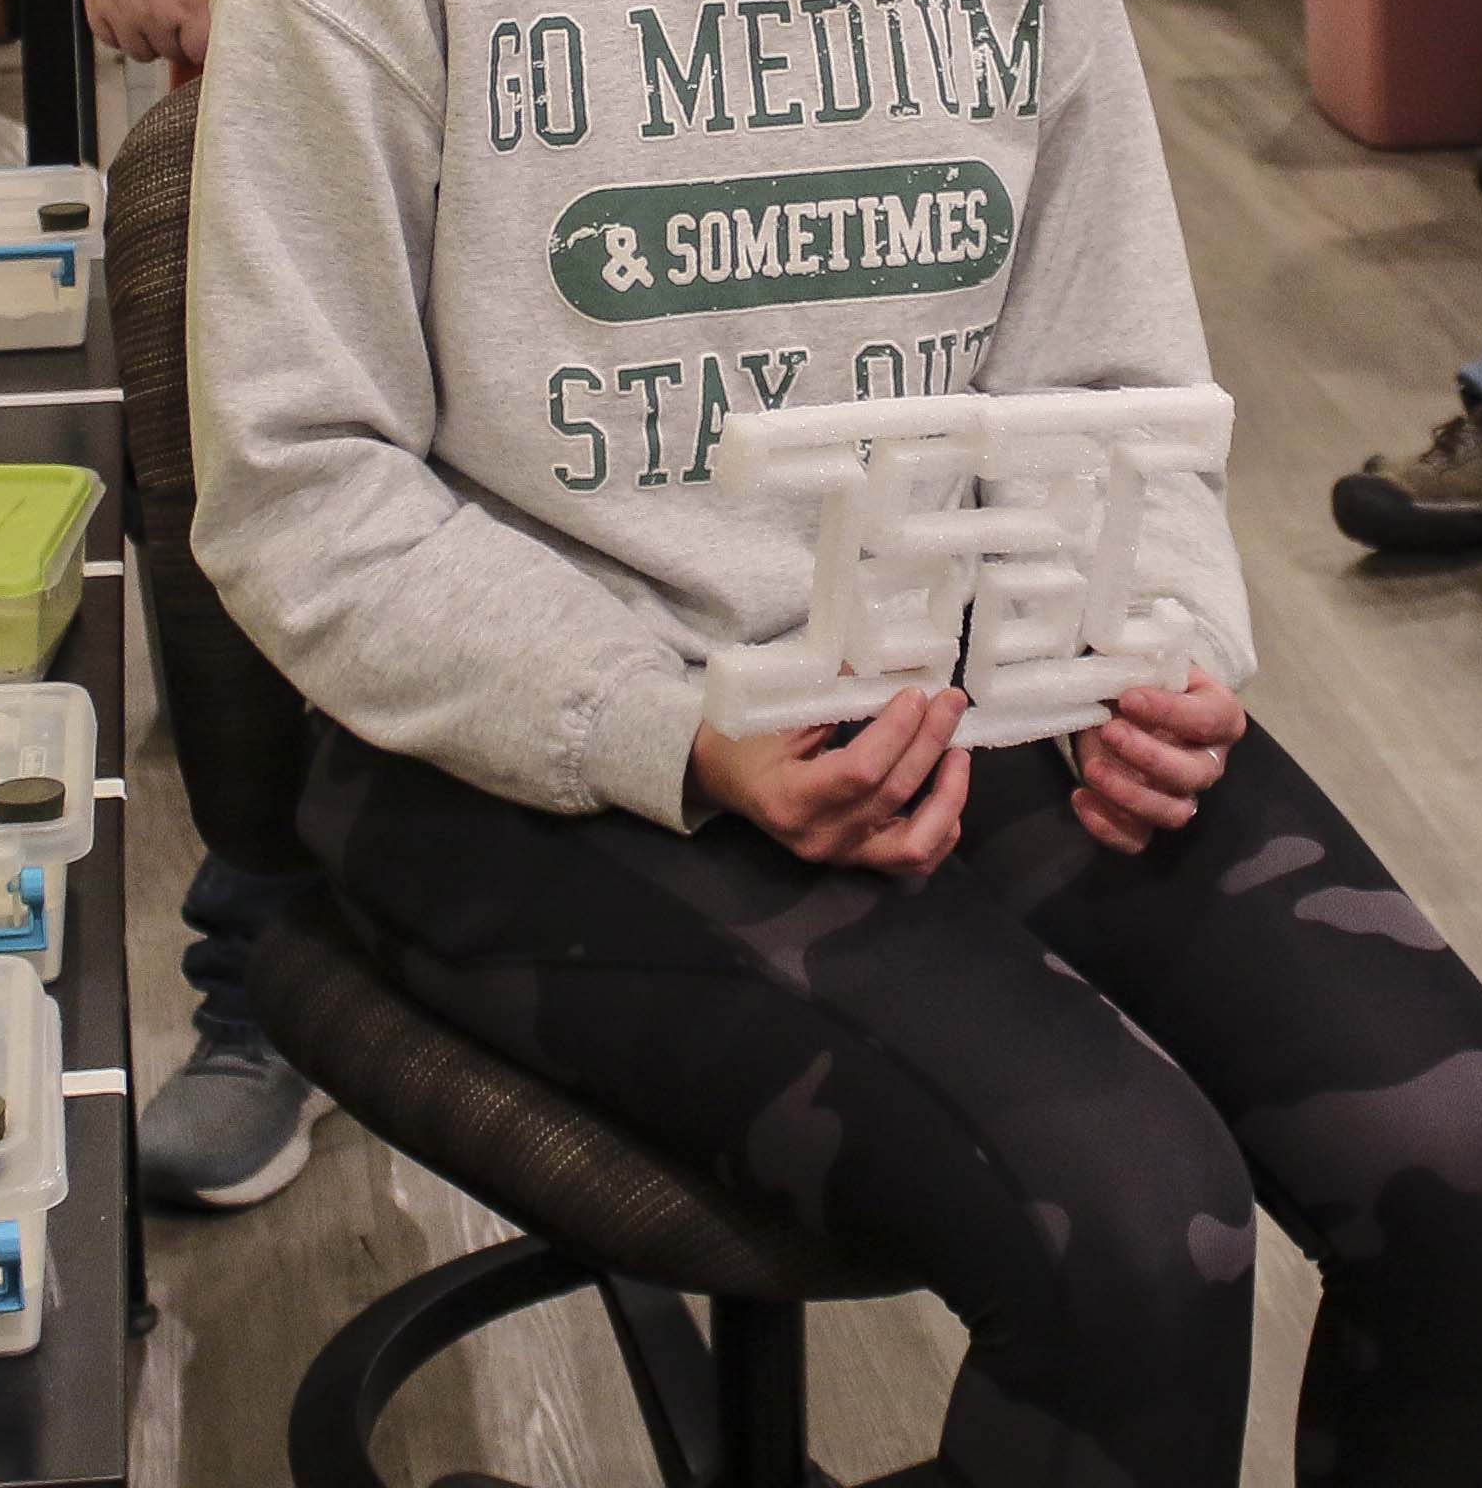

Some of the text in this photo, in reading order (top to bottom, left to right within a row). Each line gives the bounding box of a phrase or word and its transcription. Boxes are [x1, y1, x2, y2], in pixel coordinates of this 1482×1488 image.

[488, 12, 593, 153] GO
[601, 188, 989, 292] & SOMETIMES
